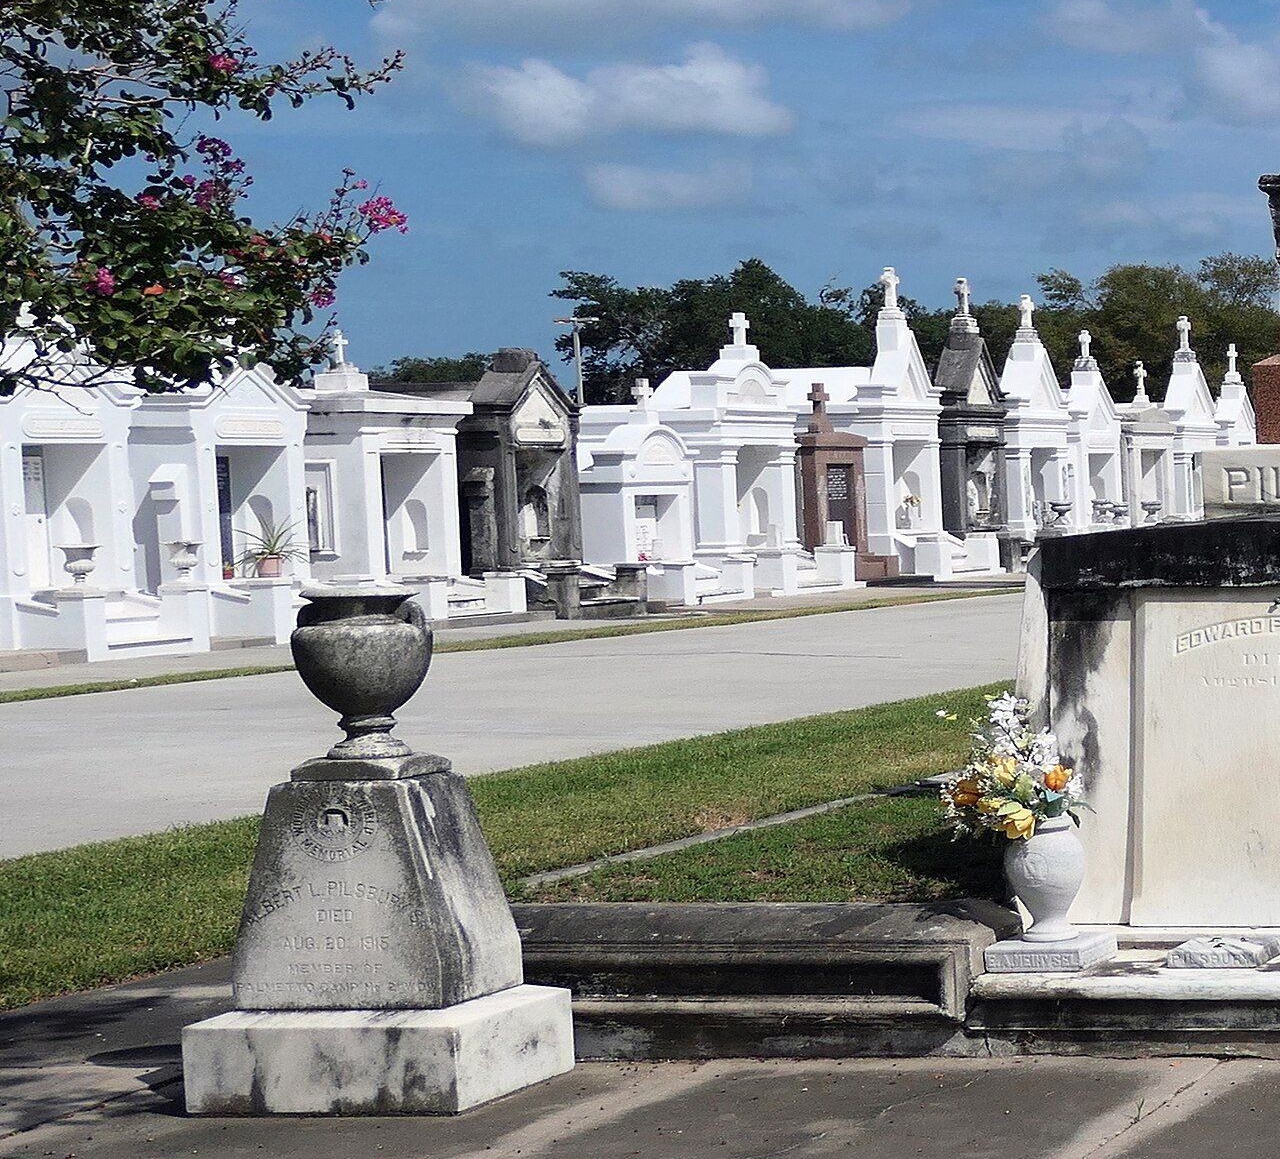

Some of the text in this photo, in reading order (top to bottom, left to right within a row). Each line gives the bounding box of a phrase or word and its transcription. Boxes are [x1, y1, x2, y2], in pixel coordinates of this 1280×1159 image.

[1175, 619, 1264, 655] EDWARD
[300, 837, 368, 861] MEMORIAL
[245, 884, 302, 928] ALBERT
[316, 909, 354, 923] DIED
[288, 962, 383, 974] MEMBER OF
